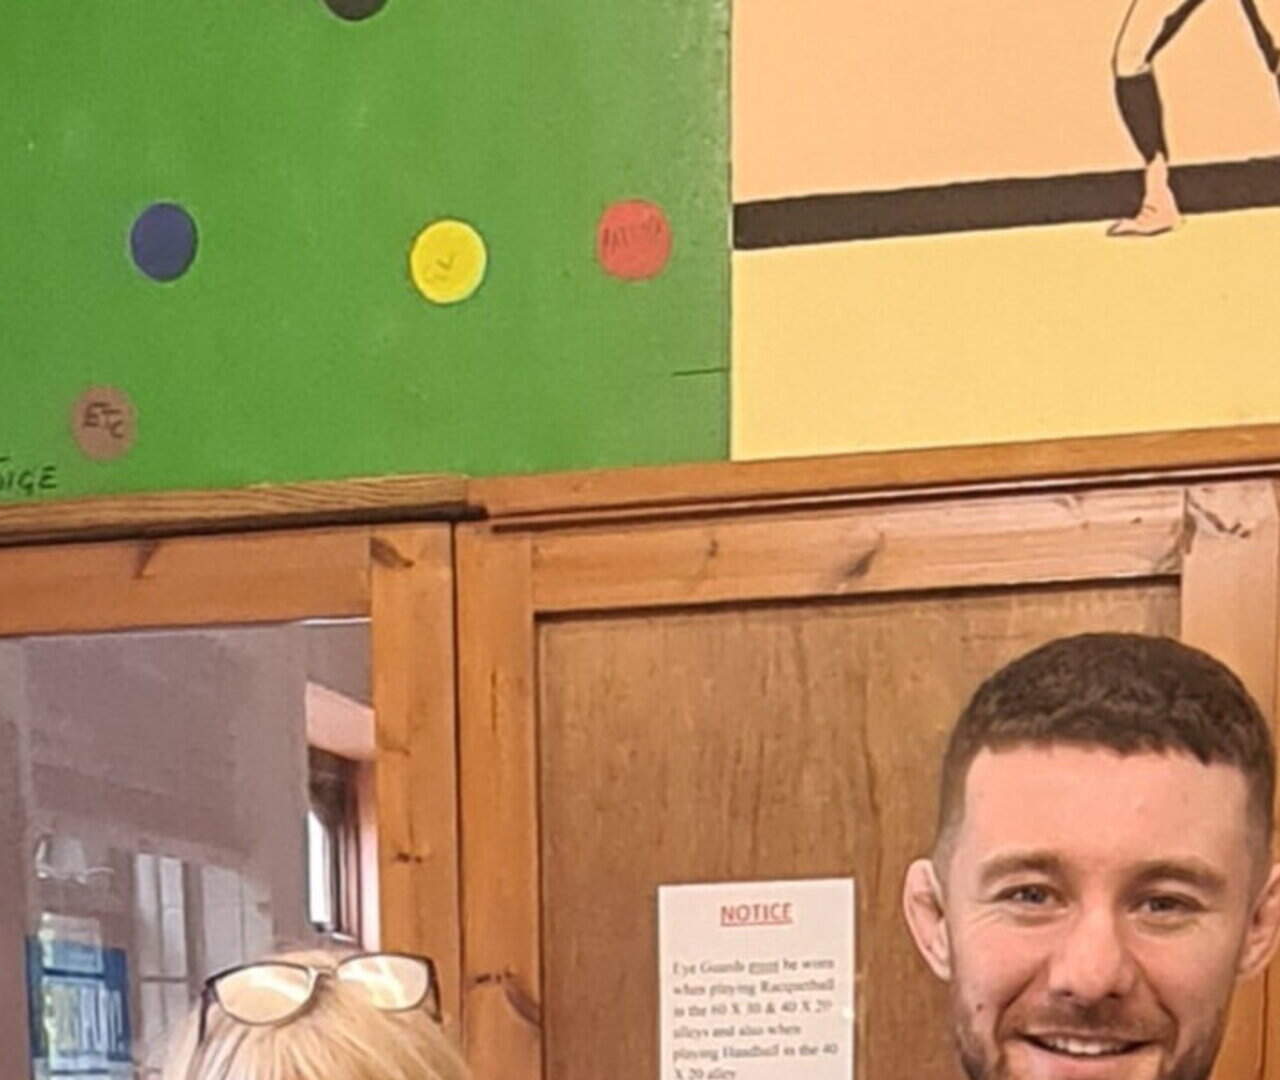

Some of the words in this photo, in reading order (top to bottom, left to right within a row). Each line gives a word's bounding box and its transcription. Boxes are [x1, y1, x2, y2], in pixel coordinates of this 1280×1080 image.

[720, 902, 793, 925] NOTICE
[710, 984, 756, 998] playing
[688, 1004, 707, 1017] the
[712, 1025, 735, 1038] and
[738, 1024, 764, 1037] also
[767, 1022, 802, 1036] when
[673, 1047, 719, 1063] playing
[722, 1043, 780, 1058] Handball
[799, 1043, 818, 1056] the
